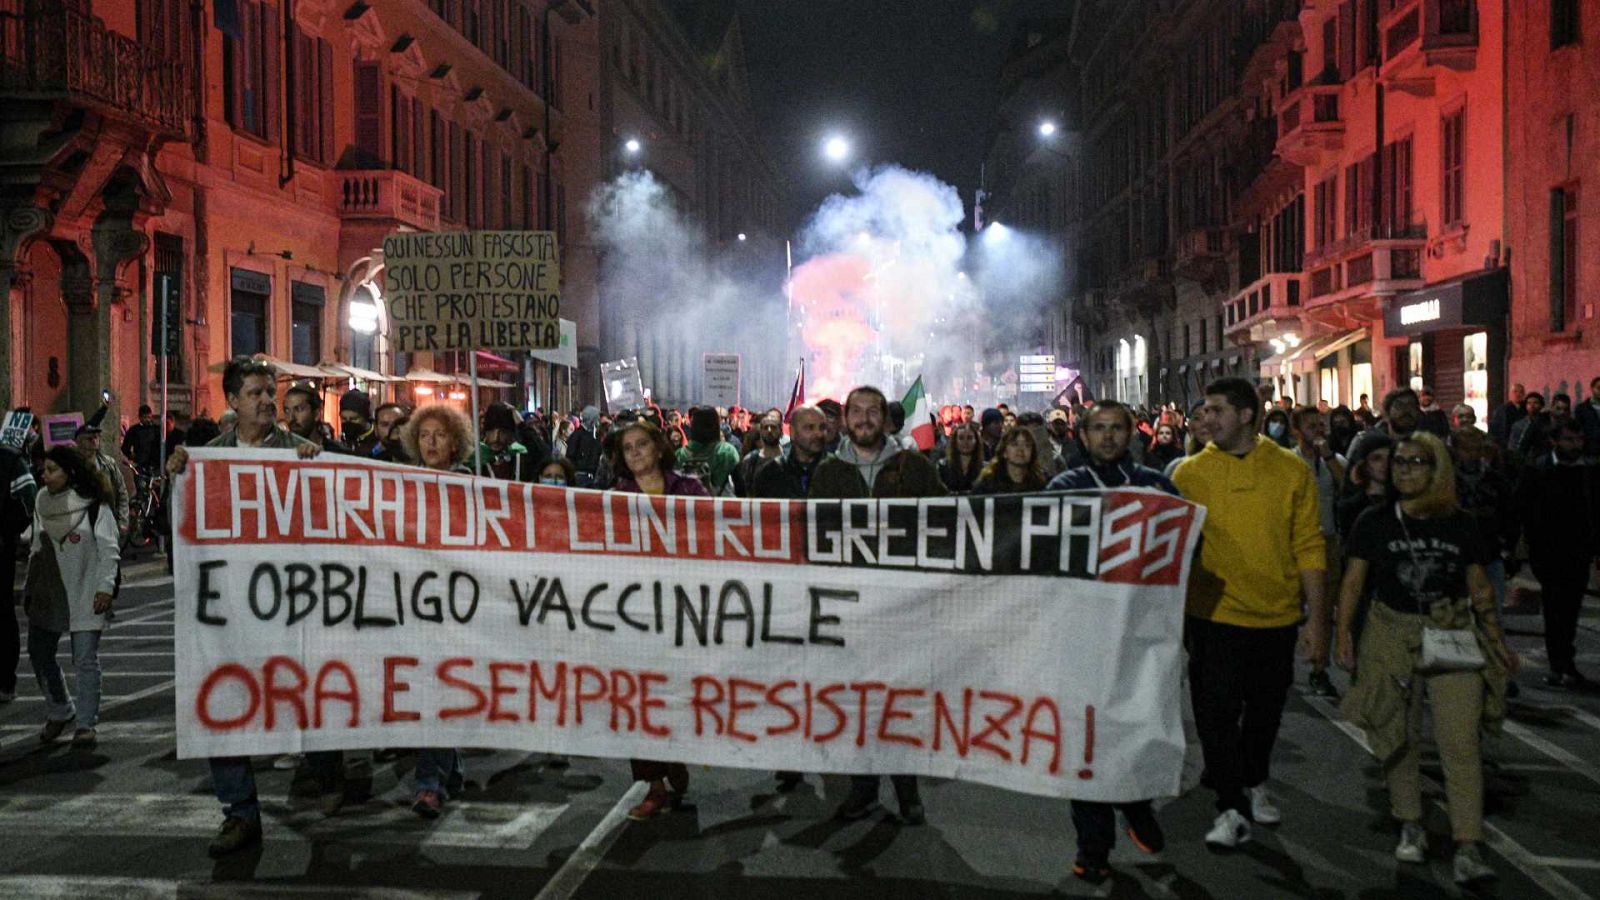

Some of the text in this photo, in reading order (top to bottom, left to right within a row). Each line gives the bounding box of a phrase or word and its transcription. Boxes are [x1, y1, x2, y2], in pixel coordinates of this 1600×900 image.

[384, 233, 558, 263] QUI NESSUN FASCISTA
[387, 261, 548, 292] SOLO PERSONE
[390, 292, 560, 321] CHE PROTESTANO
[399, 325, 439, 350] PER
[446, 322, 471, 348] LA
[195, 462, 1189, 580] LAVORATORI CONTRO GREEN PASS
[195, 559, 860, 649] E OBBLIGO VACCINALE E
[195, 655, 361, 732] ORA
[382, 656, 421, 723] E
[435, 656, 672, 738] SEMPRE
